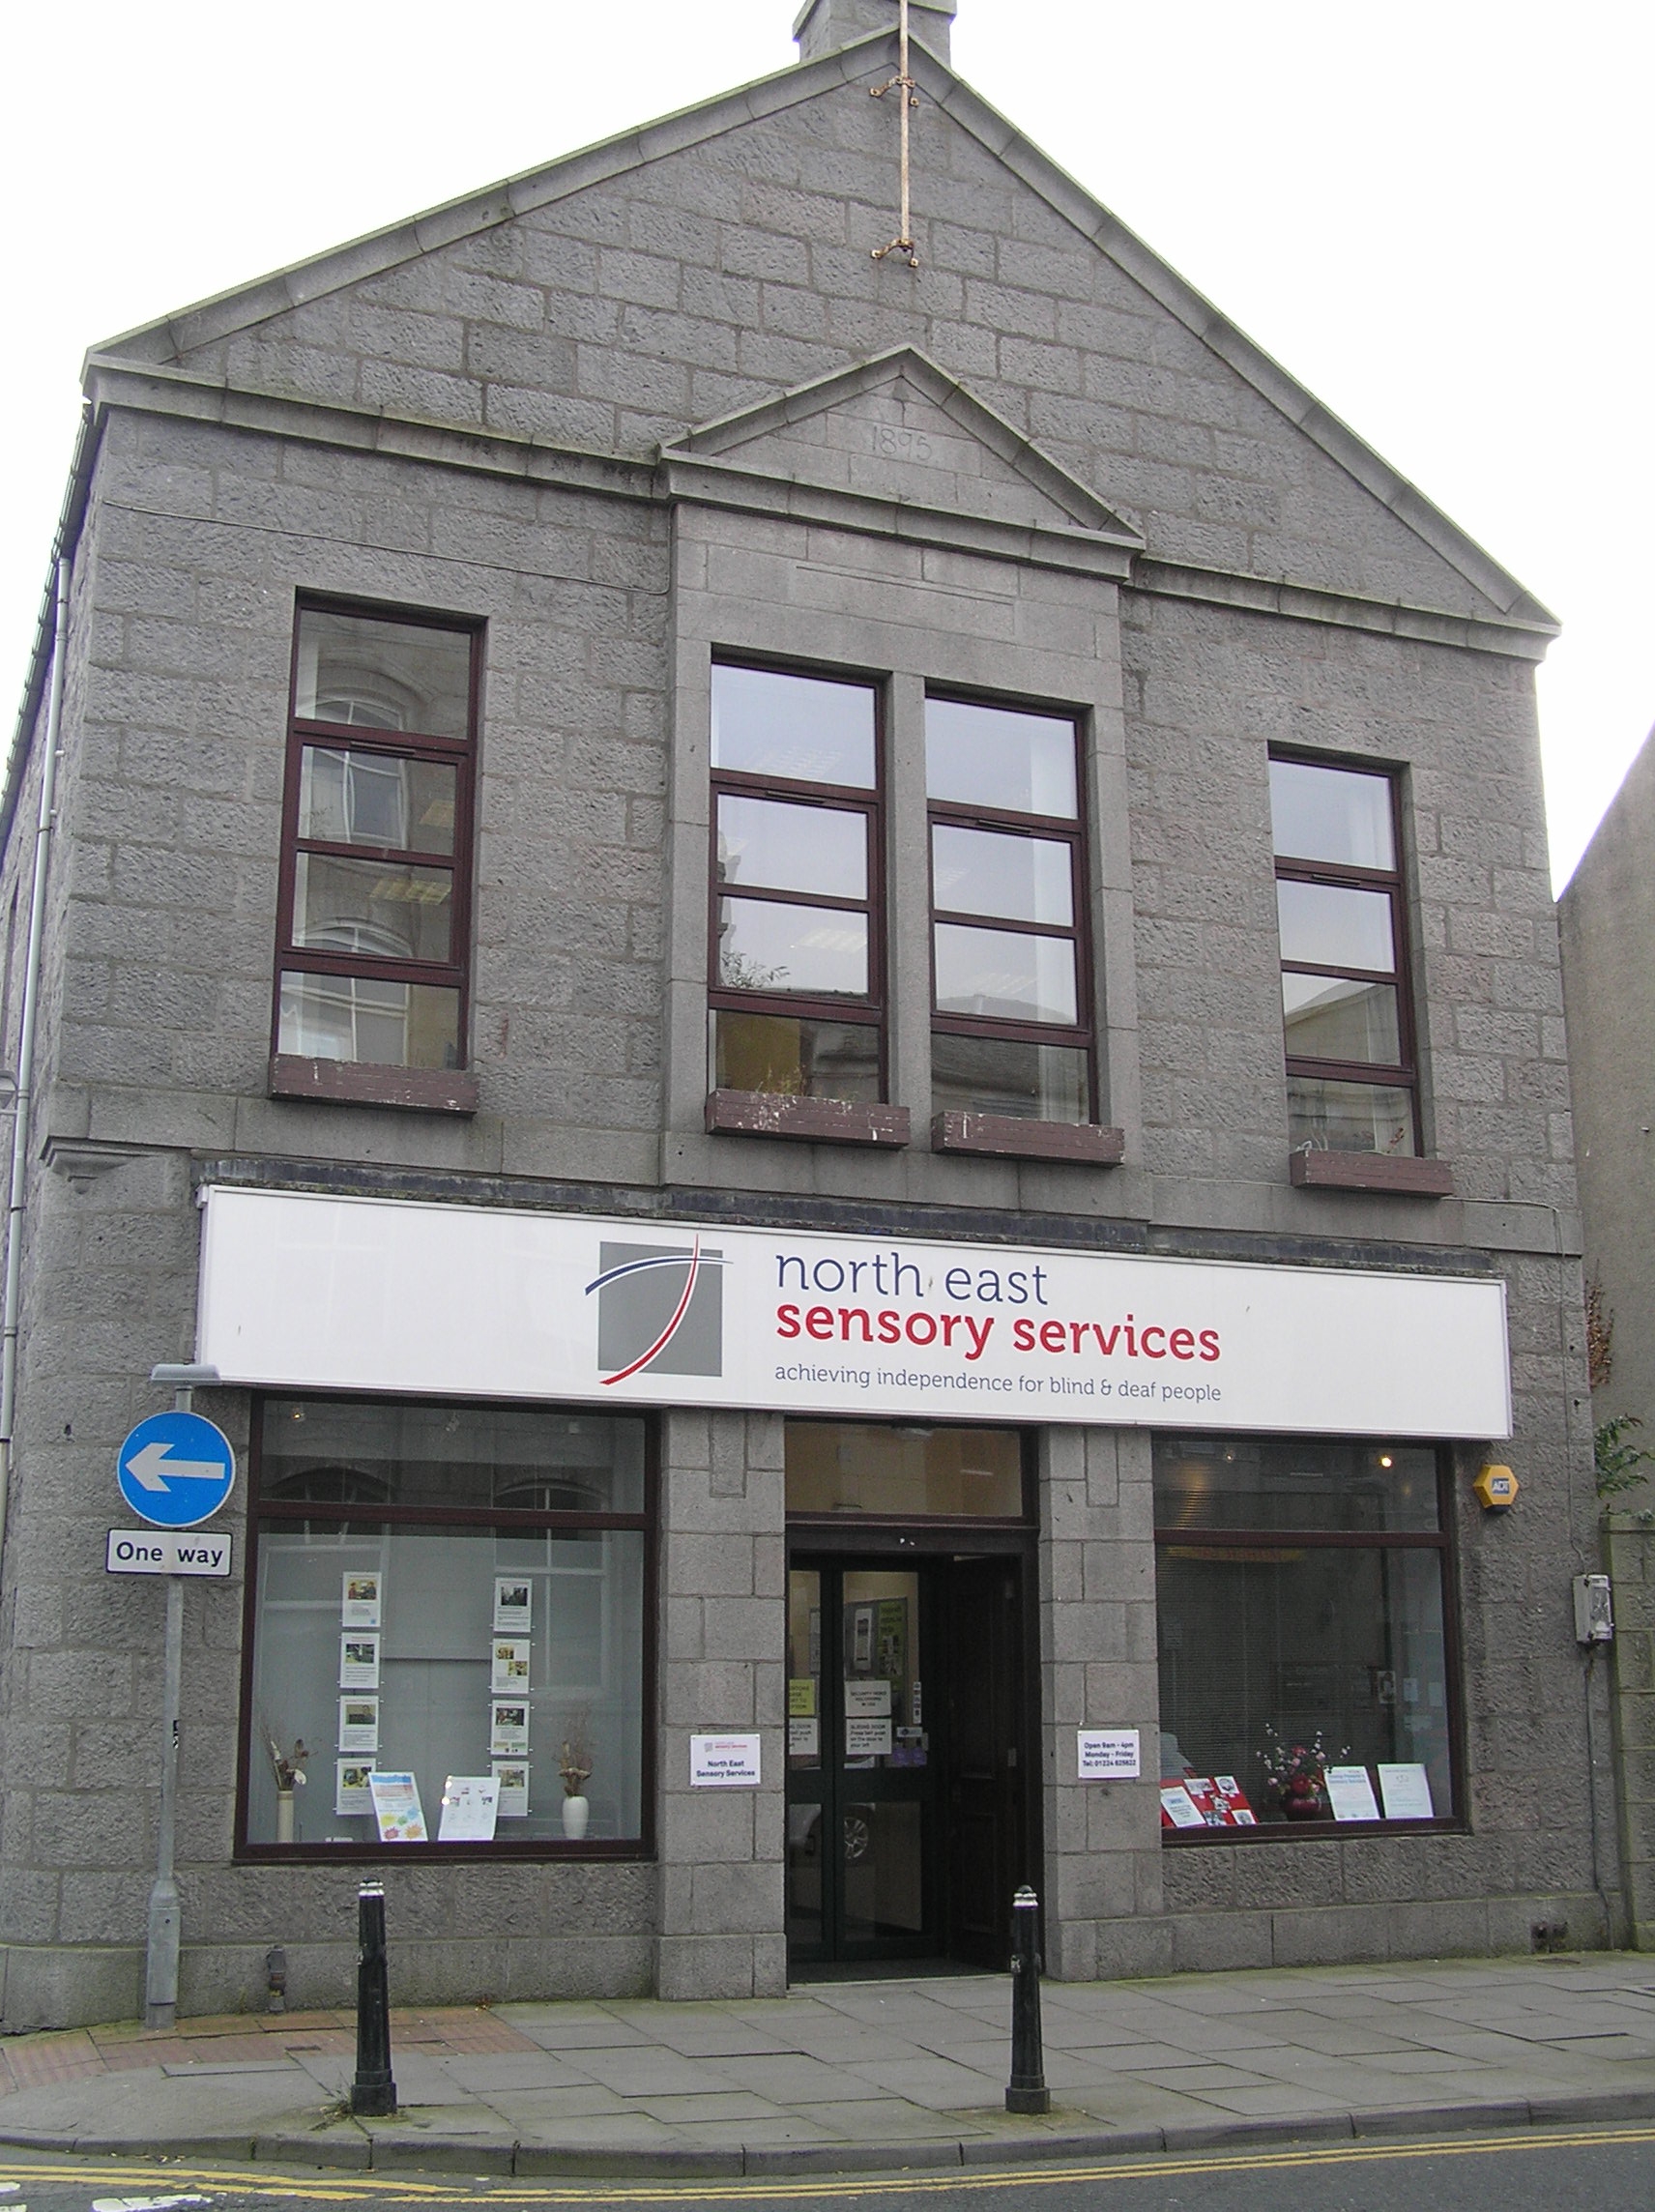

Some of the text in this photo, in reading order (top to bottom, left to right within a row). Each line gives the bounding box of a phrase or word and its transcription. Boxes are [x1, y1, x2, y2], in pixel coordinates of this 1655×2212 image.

[872, 426, 932, 460] 1895
[775, 1252, 1048, 1305] north east
[776, 1304, 1220, 1361] sensory services
[775, 1364, 1221, 1403] achieving independence for blind & deaf people
[1493, 1480, 1510, 1491] ADT
[116, 1541, 223, 1567] One way
